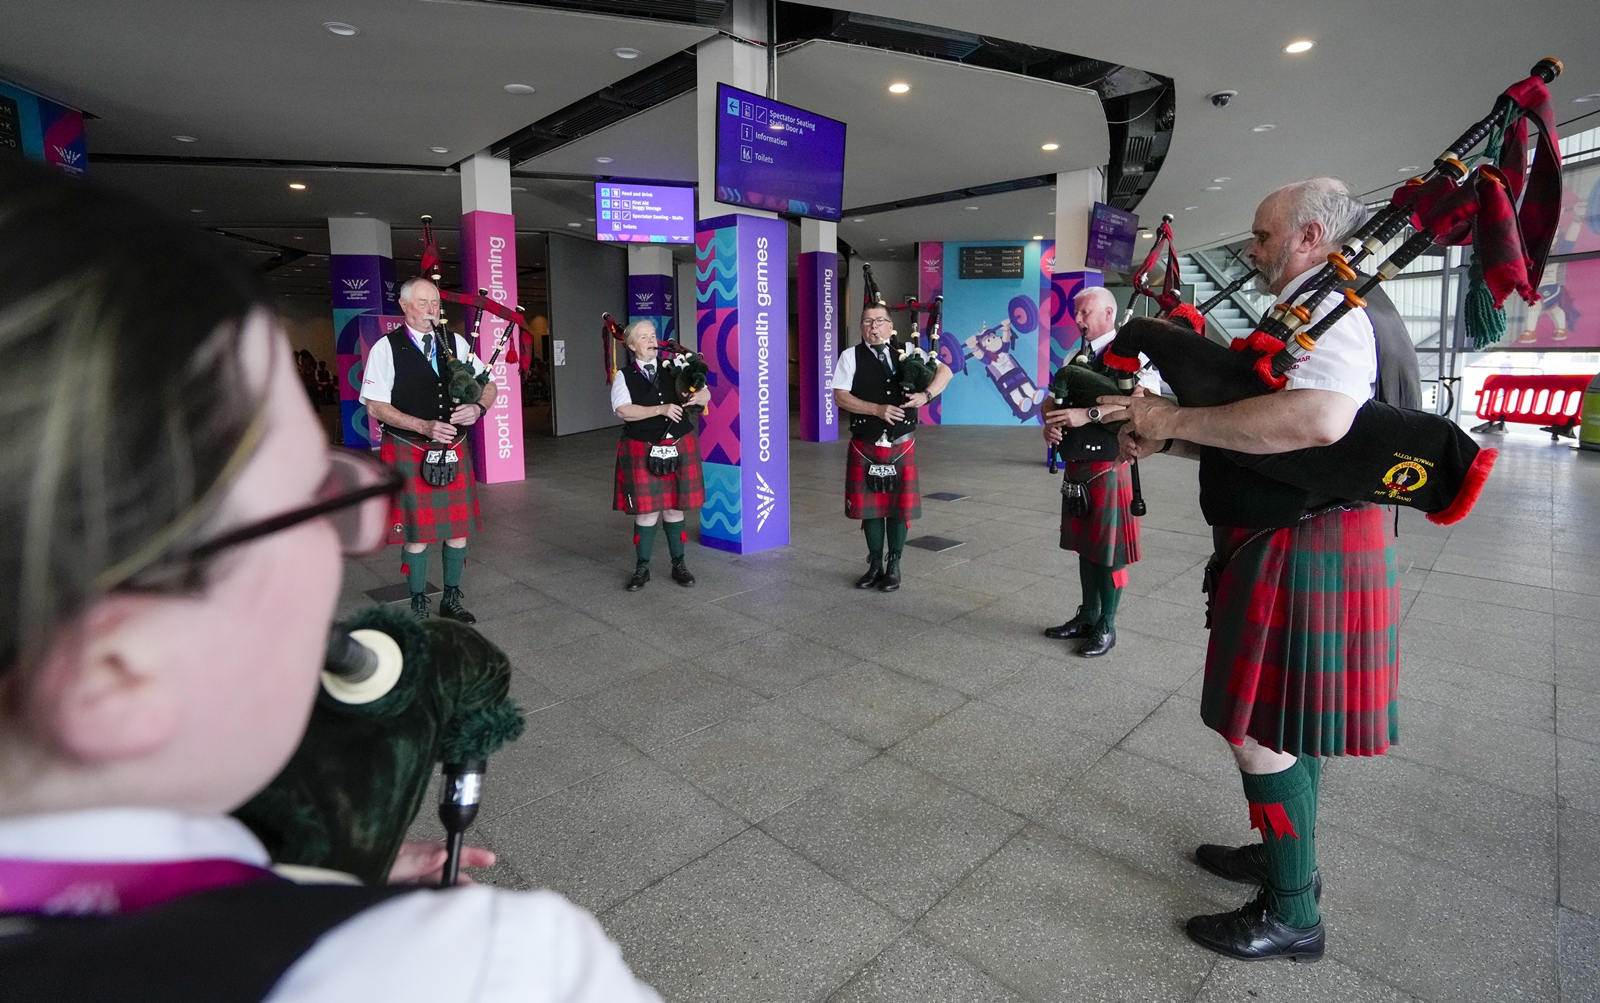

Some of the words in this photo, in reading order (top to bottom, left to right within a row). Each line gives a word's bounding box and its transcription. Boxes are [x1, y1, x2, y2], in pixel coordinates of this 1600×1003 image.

[5, 122, 12, 131] K
[769, 110, 796, 124] Spectator
[796, 118, 816, 132] Seating
[785, 123, 799, 134] Door
[9, 139, 17, 148] D
[755, 131, 788, 147] Information
[754, 152, 774, 164] Toilets
[487, 236, 509, 324] bginning
[757, 236, 772, 307] games
[823, 268, 834, 330] beginning
[492, 327, 506, 356] the
[824, 332, 832, 352] the
[494, 358, 511, 391] just
[824, 354, 834, 377] just
[755, 311, 770, 463] commonwealth
[824, 379, 832, 390] is
[494, 393, 508, 411] is
[824, 392, 834, 425] sport
[495, 414, 513, 460] sport
